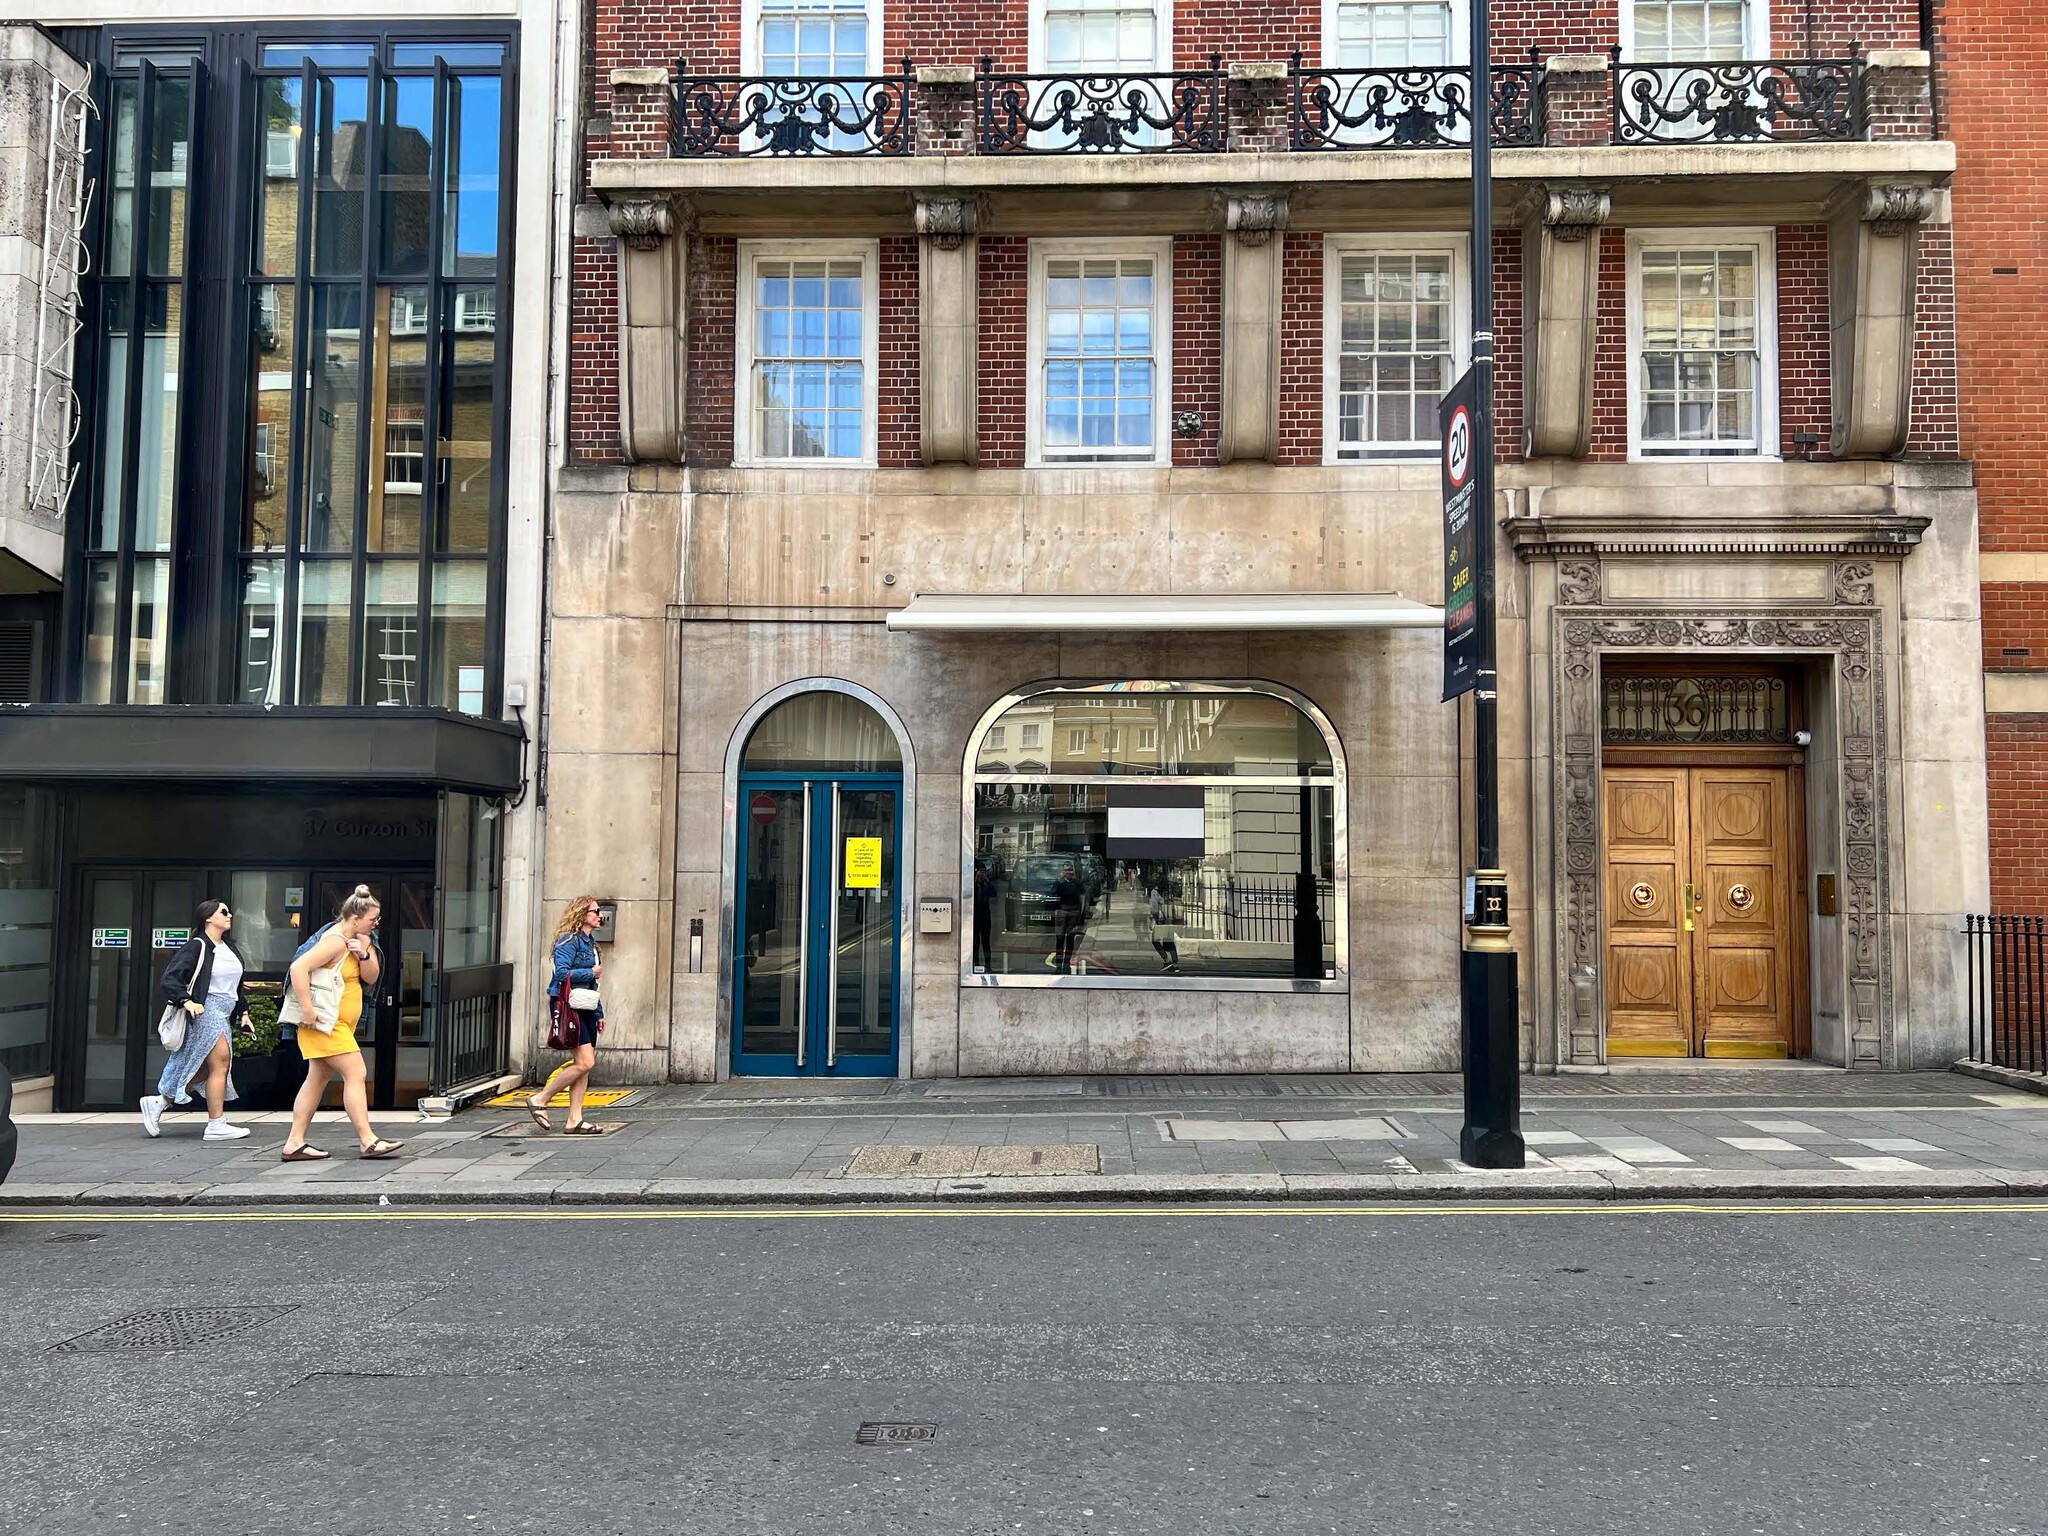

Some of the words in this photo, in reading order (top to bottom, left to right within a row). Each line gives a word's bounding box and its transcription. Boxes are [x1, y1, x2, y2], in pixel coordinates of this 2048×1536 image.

[1451, 422, 1467, 468] 20
[1452, 566, 1469, 592] SAFER
[1449, 581, 1474, 612] GREENER
[1449, 601, 1474, 630] CLEANER
[1670, 692, 1706, 727] 36
[334, 819, 408, 838] Curzon
[690, 918, 703, 926] 36
